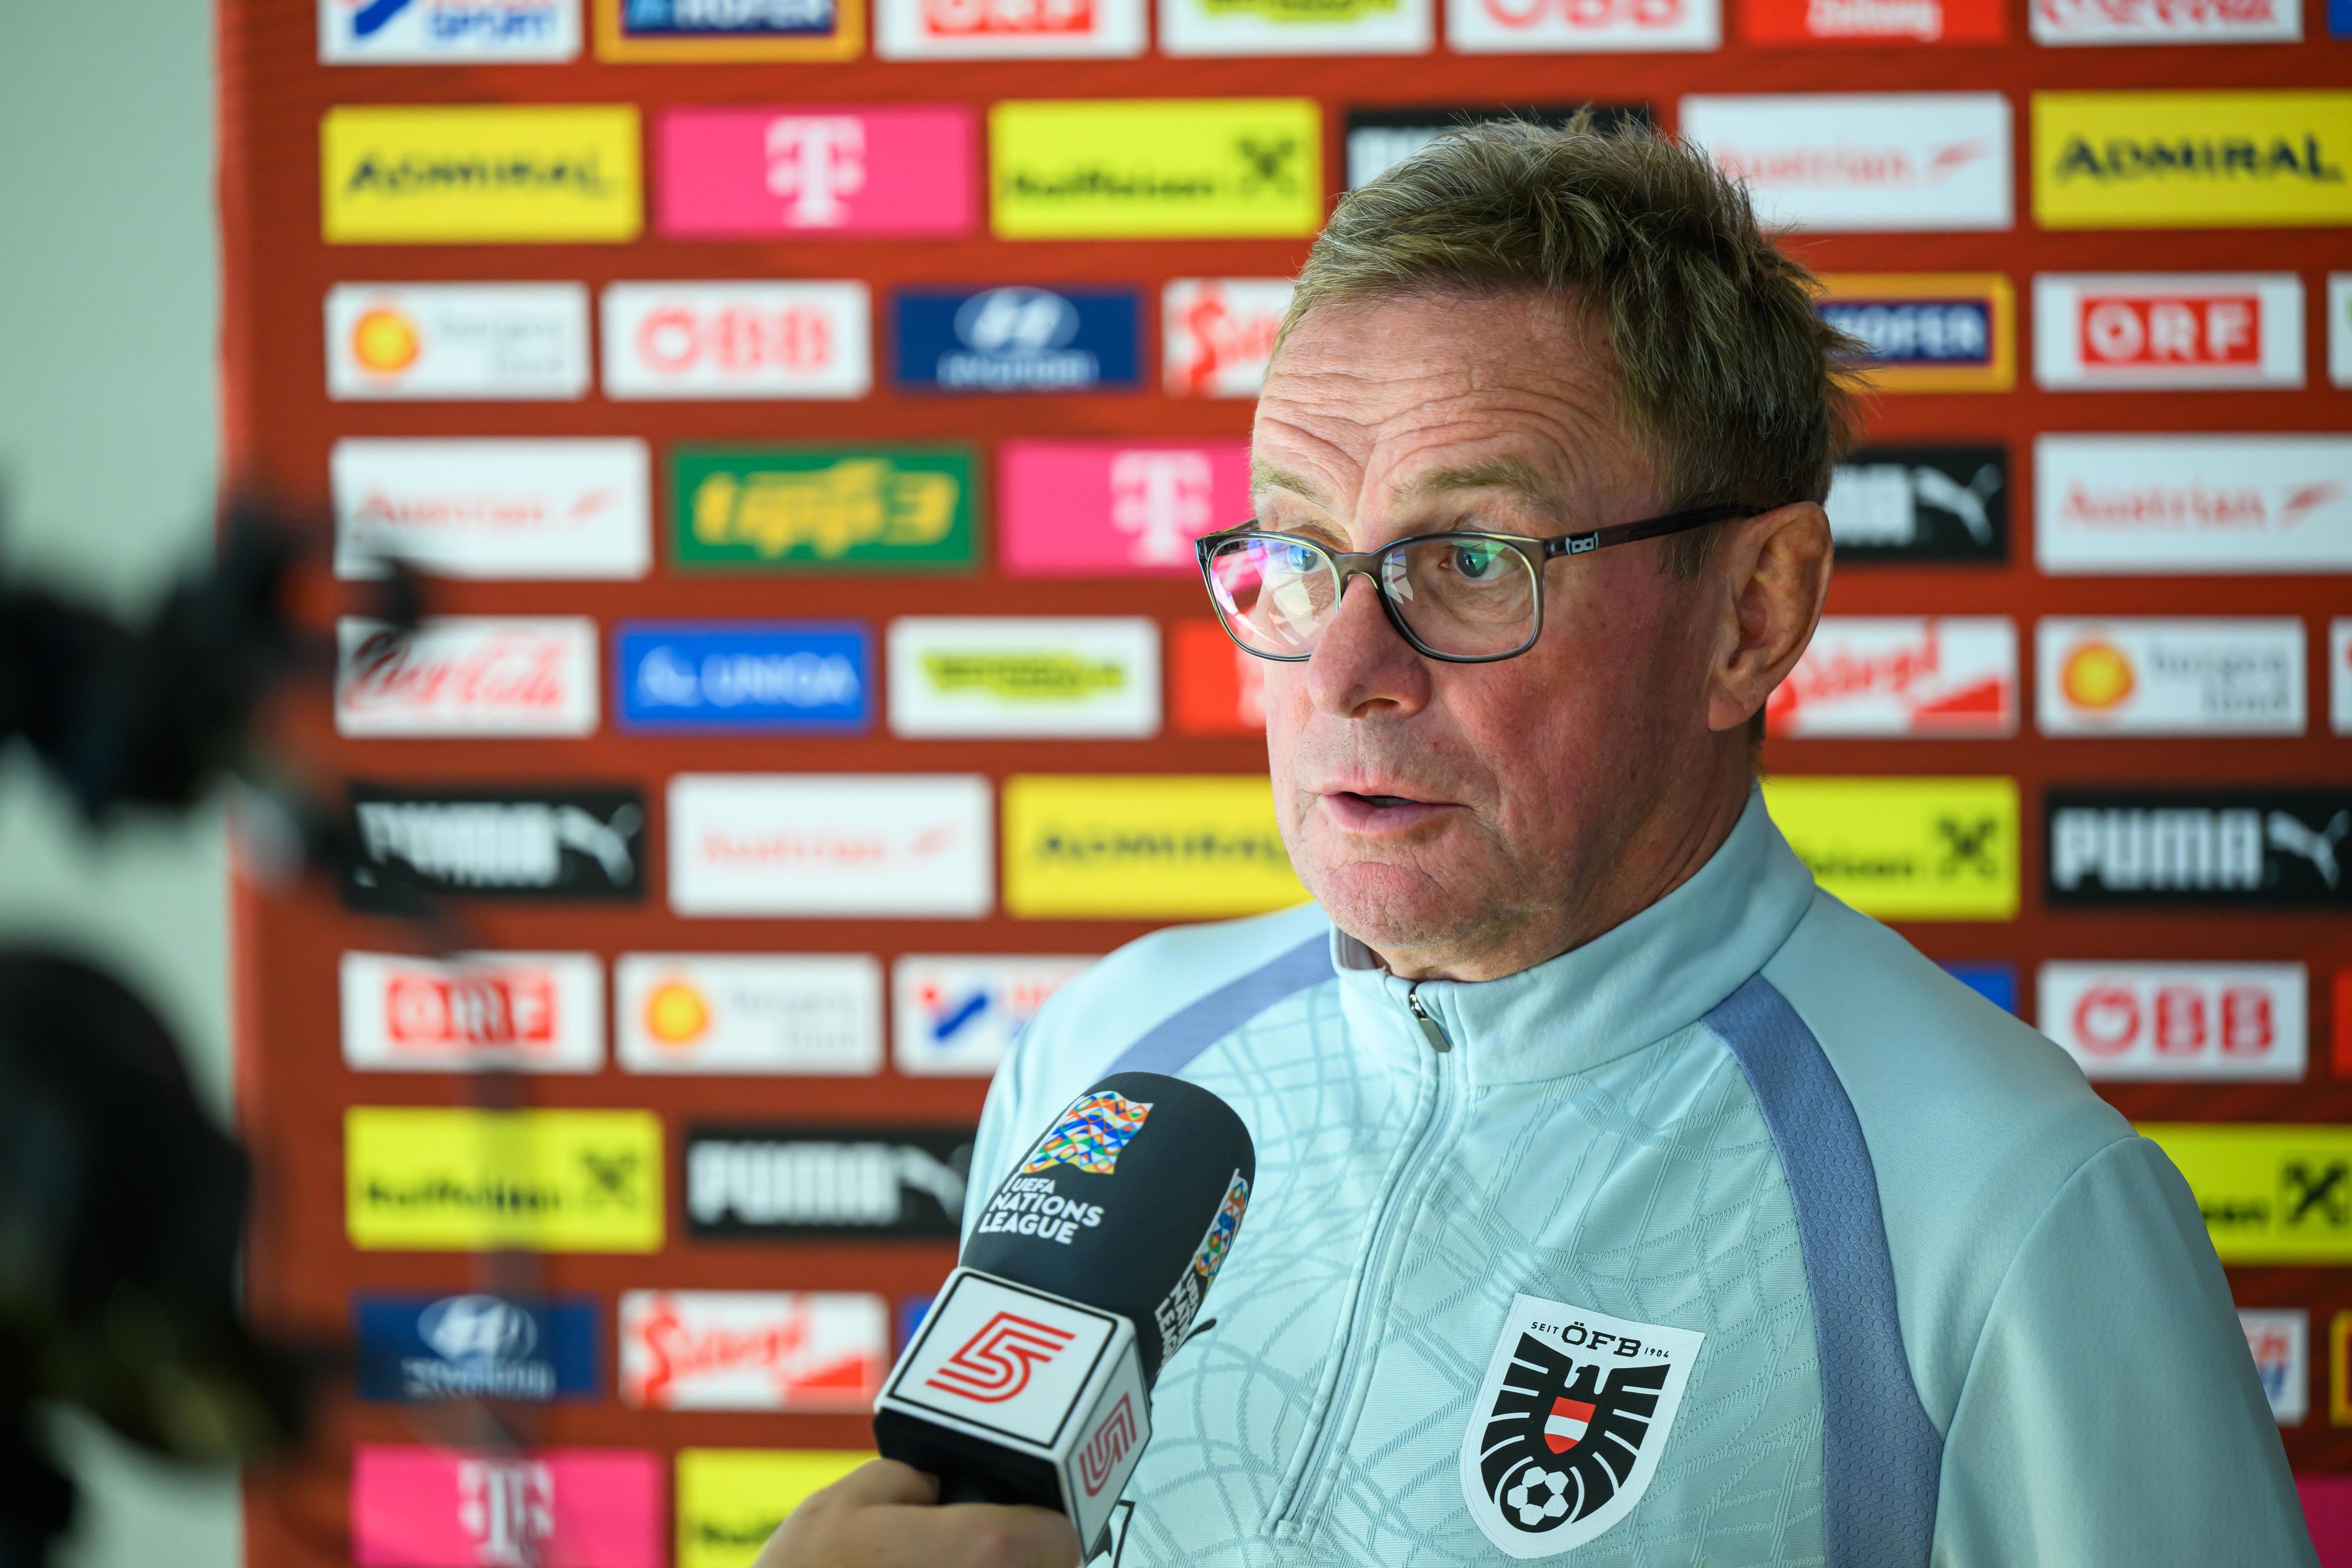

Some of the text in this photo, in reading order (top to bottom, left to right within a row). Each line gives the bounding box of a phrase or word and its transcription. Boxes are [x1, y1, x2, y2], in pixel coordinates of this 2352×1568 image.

[2055, 135, 2346, 185] ADMIRAL
[2086, 303, 2253, 362] ORF
[2058, 477, 2269, 529] Austrian
[2051, 810, 2264, 890] PUMA
[688, 1142, 902, 1224] PUMA
[1013, 1178, 1056, 1195] UEFA
[978, 1213, 1078, 1245] LEAGUE
[989, 1194, 1105, 1228] NATIONS
[1531, 1321, 1670, 1359] SEIT ÖFB 1904
